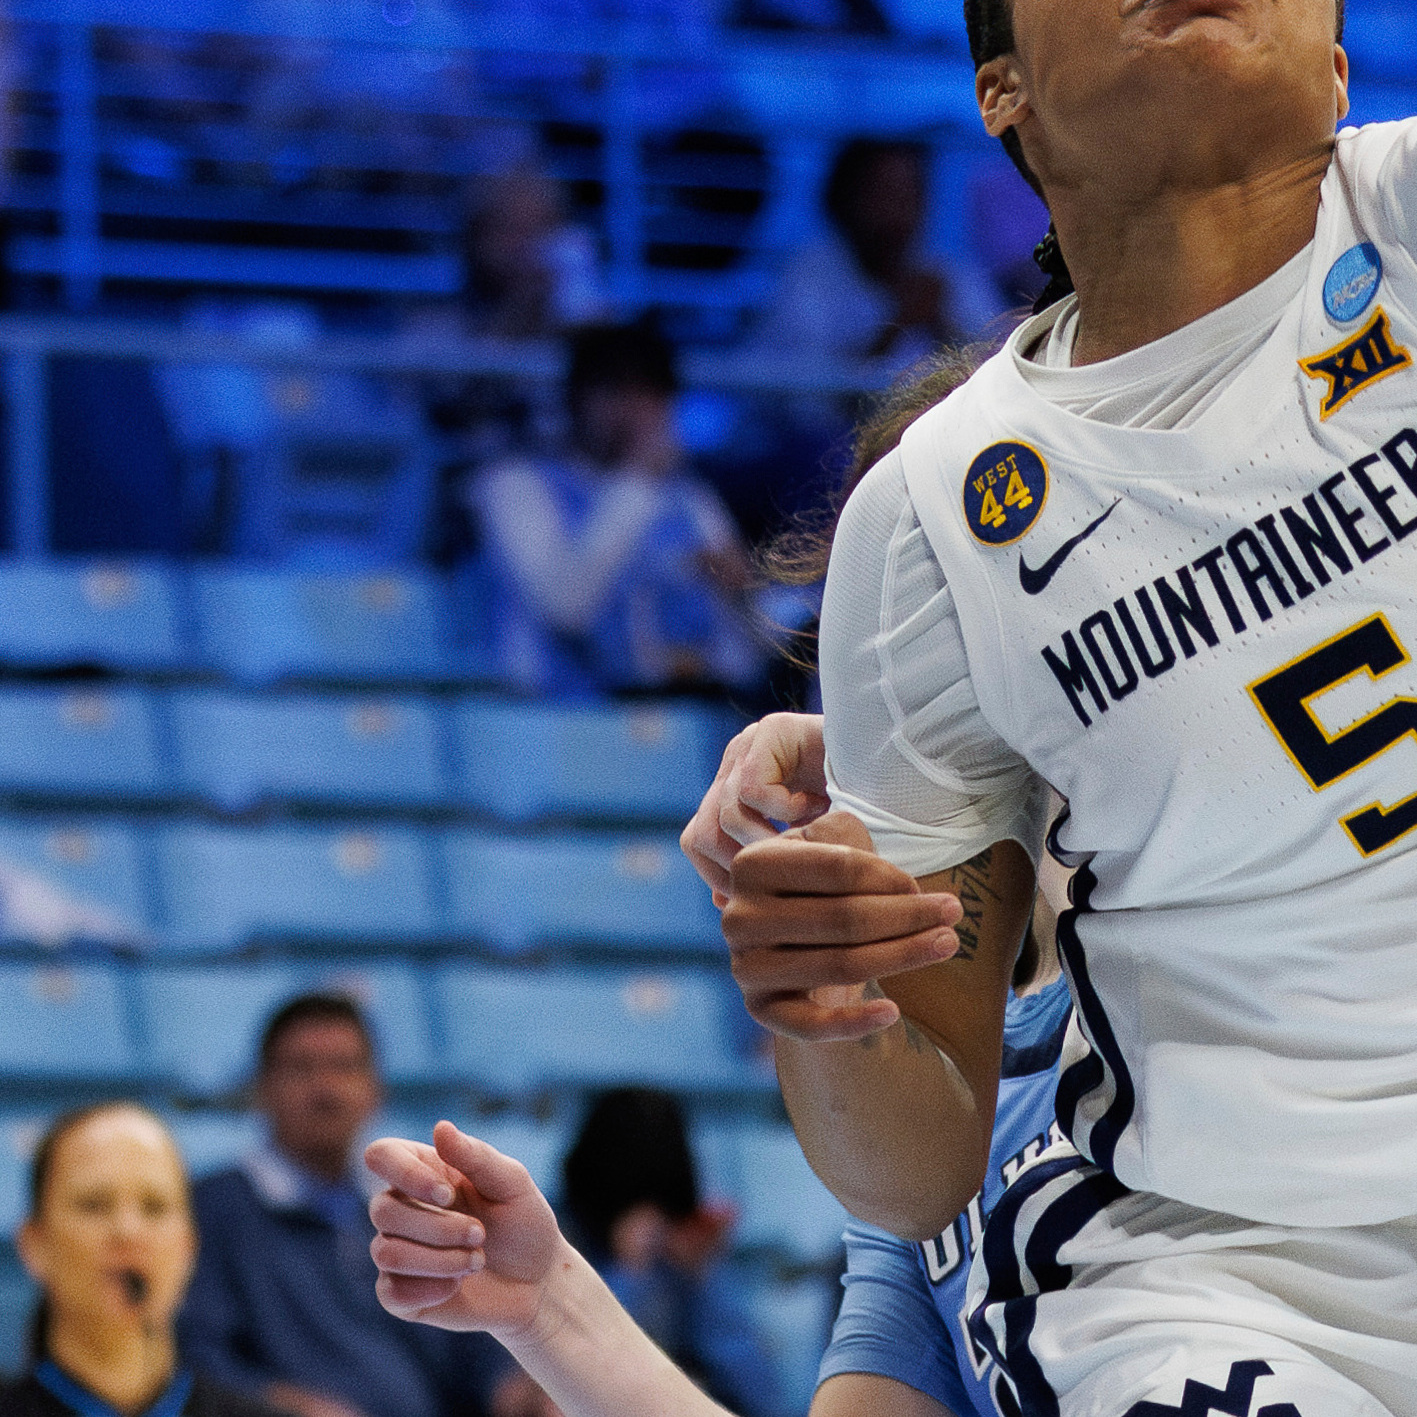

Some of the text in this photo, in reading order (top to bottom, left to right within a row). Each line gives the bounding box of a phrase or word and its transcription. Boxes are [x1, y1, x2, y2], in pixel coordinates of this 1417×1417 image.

[1304, 312, 1408, 413] XII
[972, 453, 1017, 494] WEST
[979, 469, 1034, 529] 44
